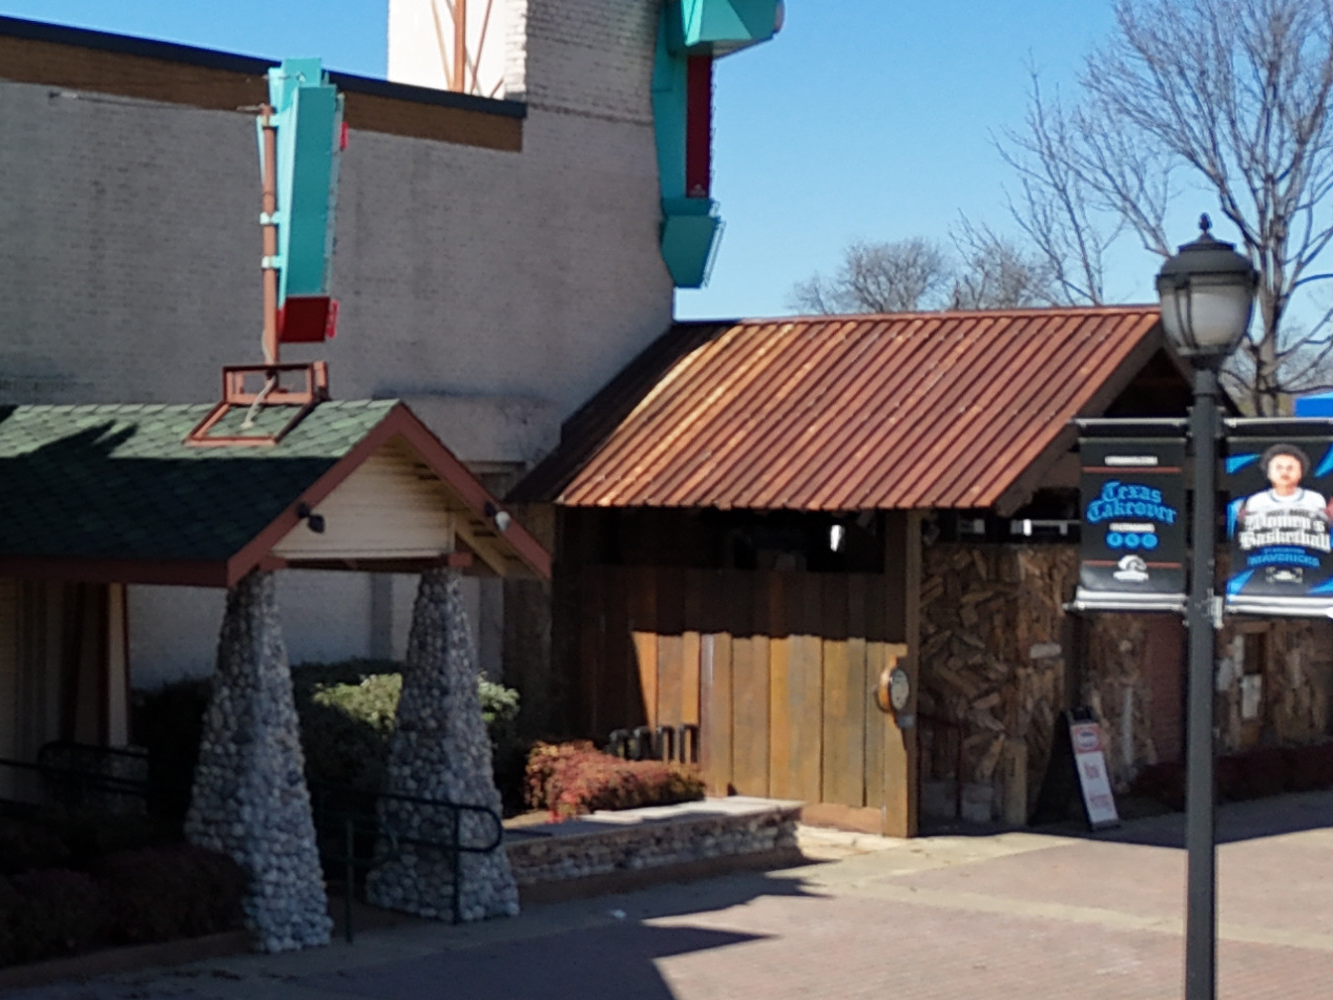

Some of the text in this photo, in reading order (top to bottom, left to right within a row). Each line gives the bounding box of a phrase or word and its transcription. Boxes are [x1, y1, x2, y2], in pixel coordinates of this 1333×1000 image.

[1101, 481, 1162, 504] Texas
[1086, 498, 1177, 524] Takeover
[1239, 528, 1332, 553] Basketball
